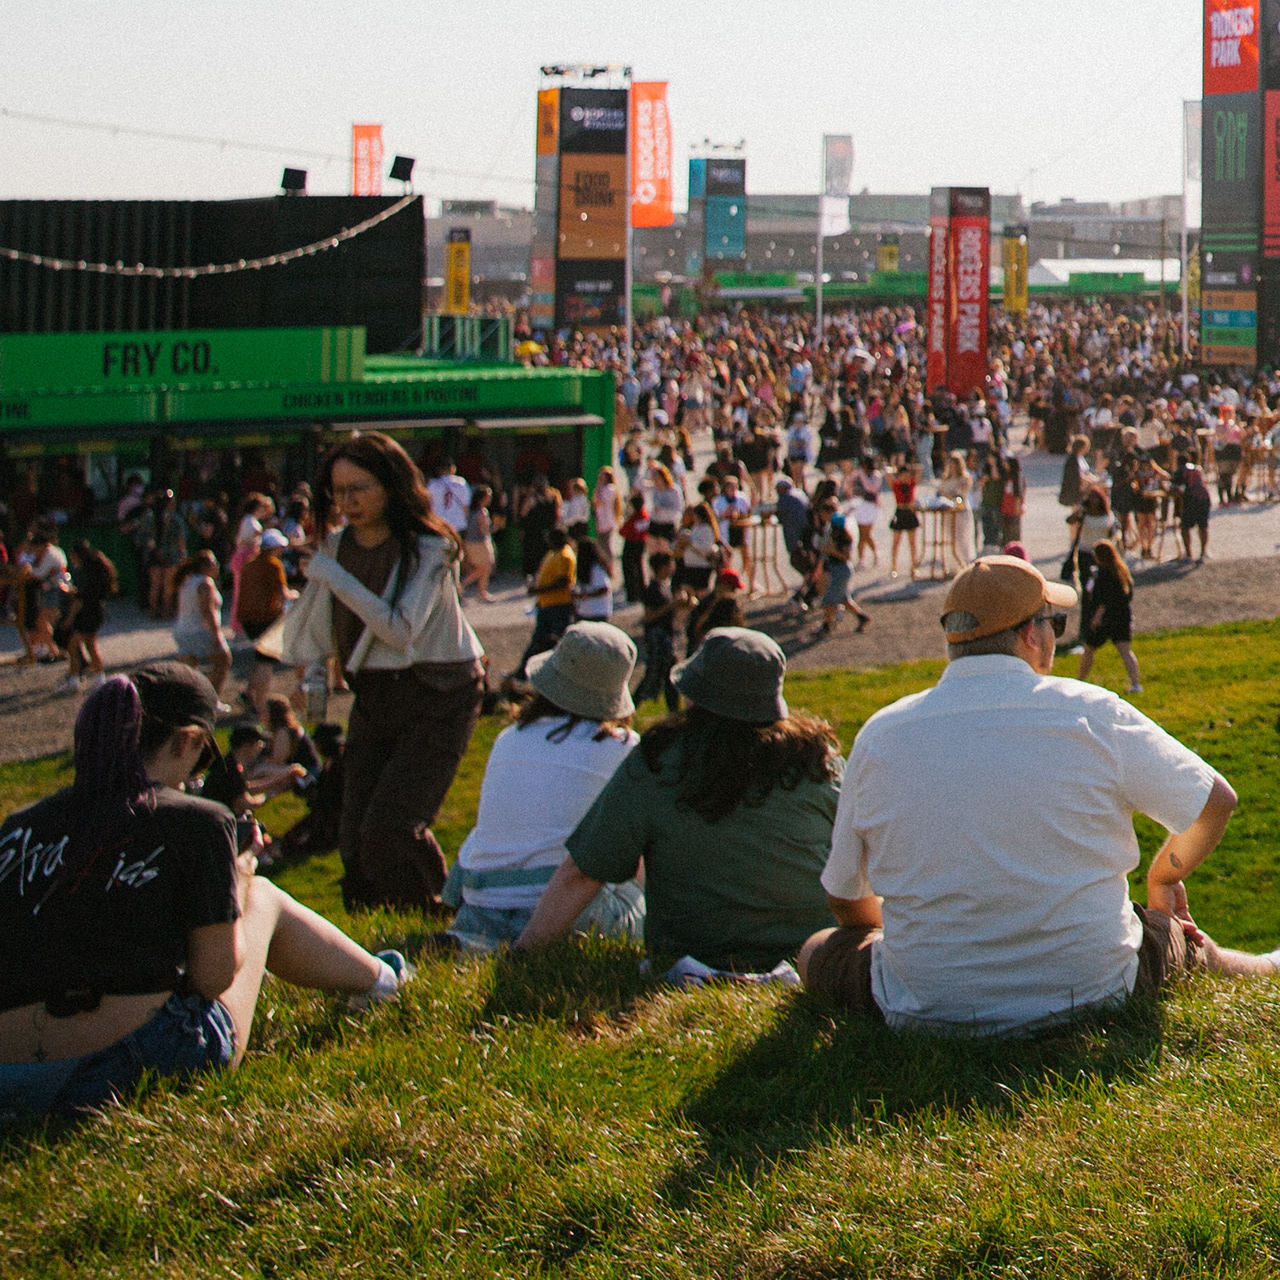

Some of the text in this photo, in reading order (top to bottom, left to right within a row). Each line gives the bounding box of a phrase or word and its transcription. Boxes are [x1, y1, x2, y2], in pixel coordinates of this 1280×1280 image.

[1211, 7, 1254, 38] ROGERS
[1211, 39, 1242, 68] PARK
[958, 227, 982, 300] ROGERS
[956, 302, 980, 354] PARK
[103, 340, 219, 375] FRY CO.
